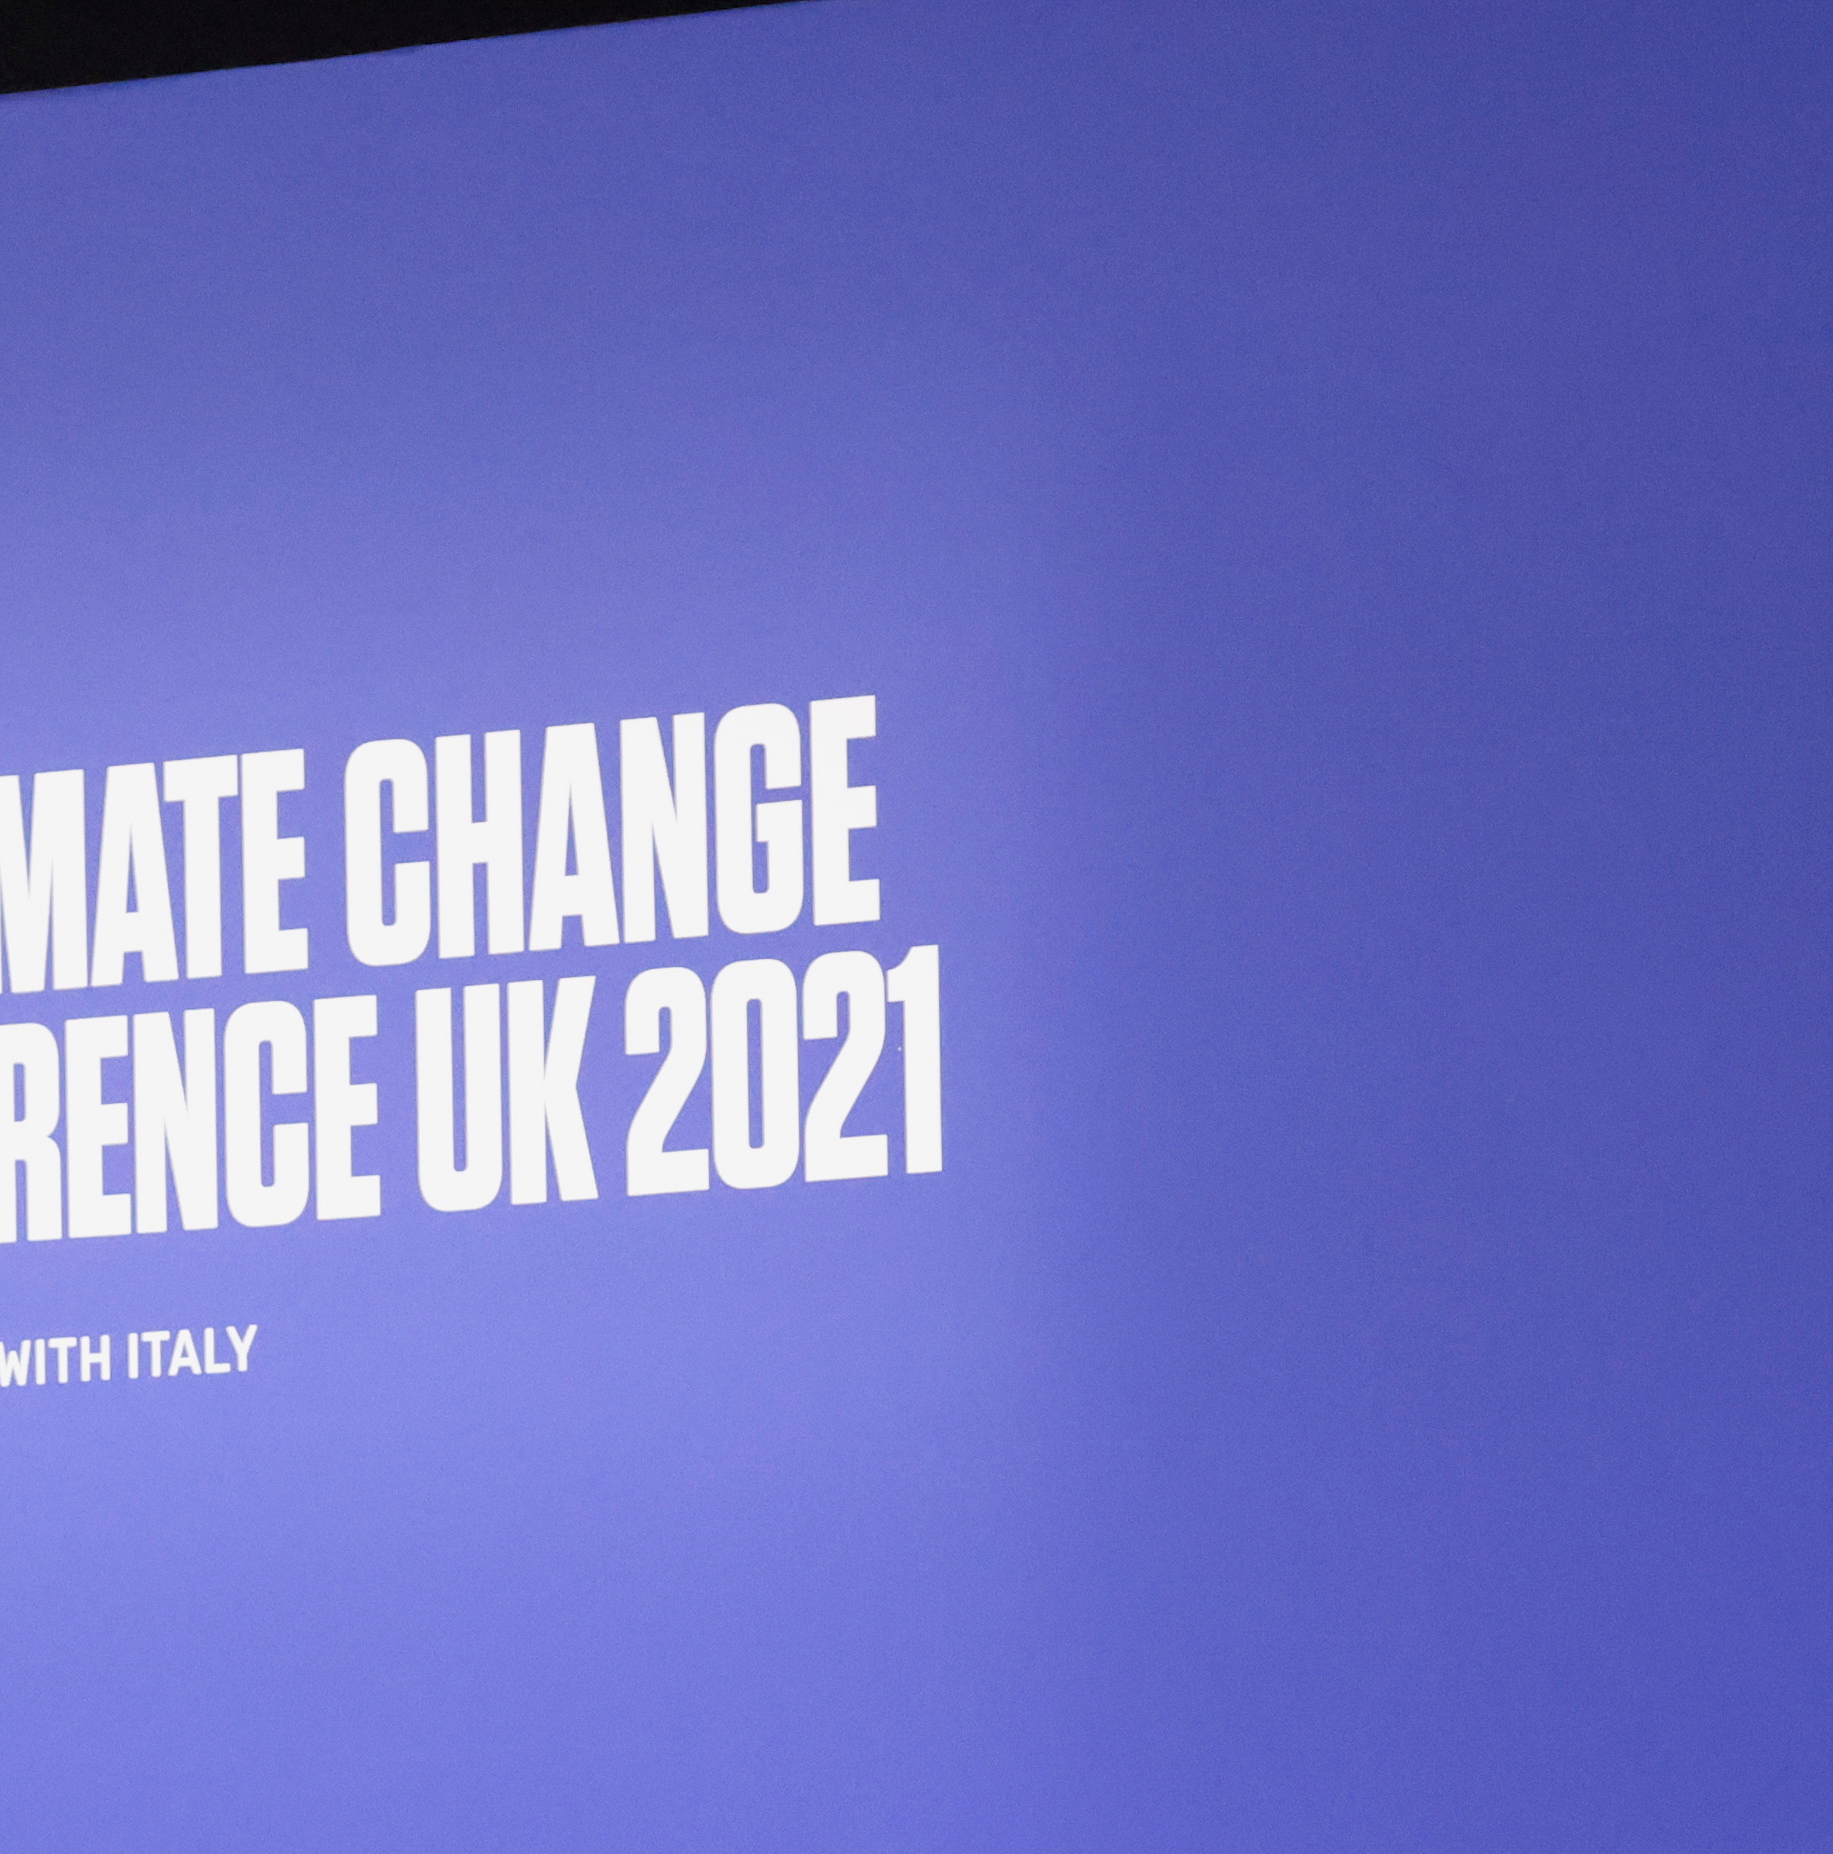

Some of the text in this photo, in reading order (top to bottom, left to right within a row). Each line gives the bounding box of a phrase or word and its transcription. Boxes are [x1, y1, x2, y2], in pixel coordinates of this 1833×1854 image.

[344, 694, 880, 967] CHANGE
[415, 975, 599, 1213] UK
[625, 944, 944, 1197] 2021
[127, 1324, 259, 1380] ITALY
